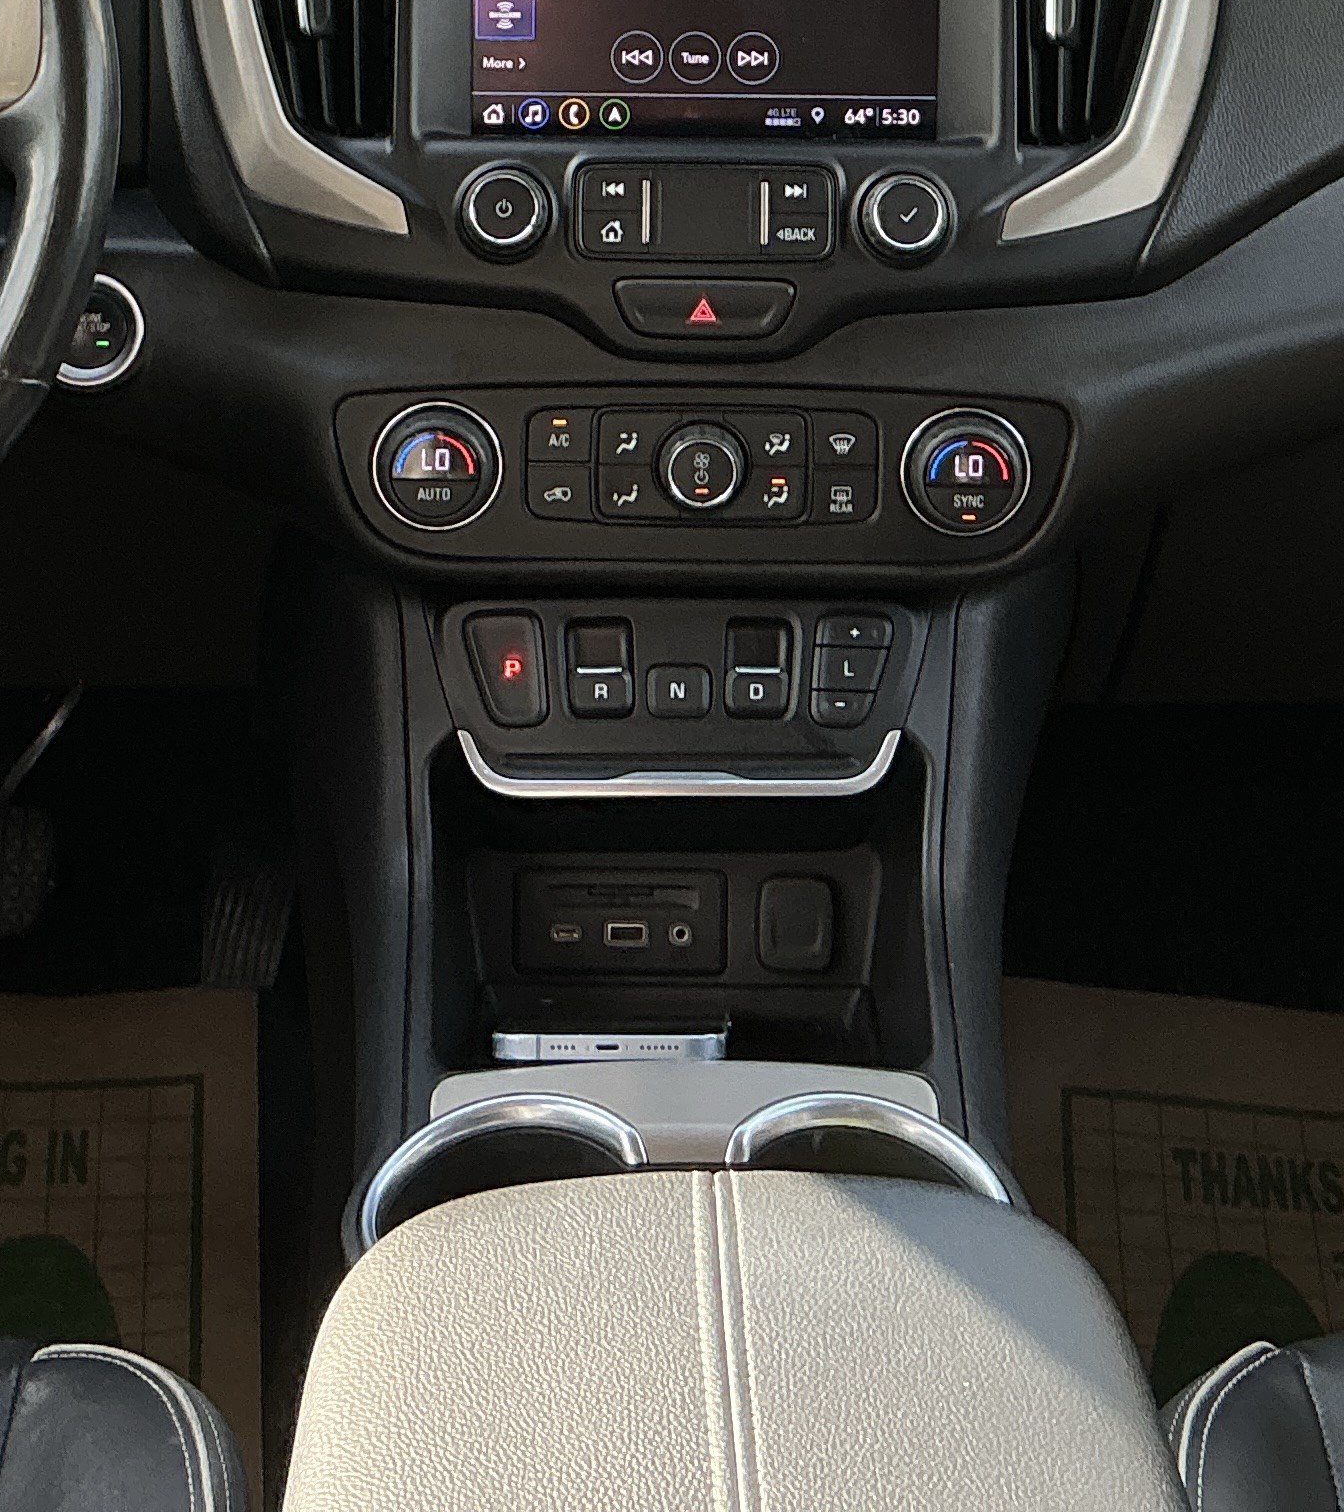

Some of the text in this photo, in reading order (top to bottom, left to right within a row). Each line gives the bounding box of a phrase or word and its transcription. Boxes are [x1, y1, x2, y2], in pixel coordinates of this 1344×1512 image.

[482, 56, 514, 71] More
[680, 51, 710, 65] Tune
[766, 107, 798, 119] 4G LTE
[881, 109, 921, 126] 5:30
[784, 226, 817, 243] BACK
[548, 433, 570, 448] A/C
[421, 448, 450, 472] LO
[954, 455, 984, 479] LO
[416, 487, 451, 502] AUTO
[952, 493, 985, 509] SYNC
[828, 502, 854, 514] REAR
[503, 658, 522, 677] P
[843, 660, 855, 677] L
[594, 683, 608, 701] R
[669, 683, 686, 701] N
[748, 683, 764, 701] D
[45, 1126, 91, 1186] IN
